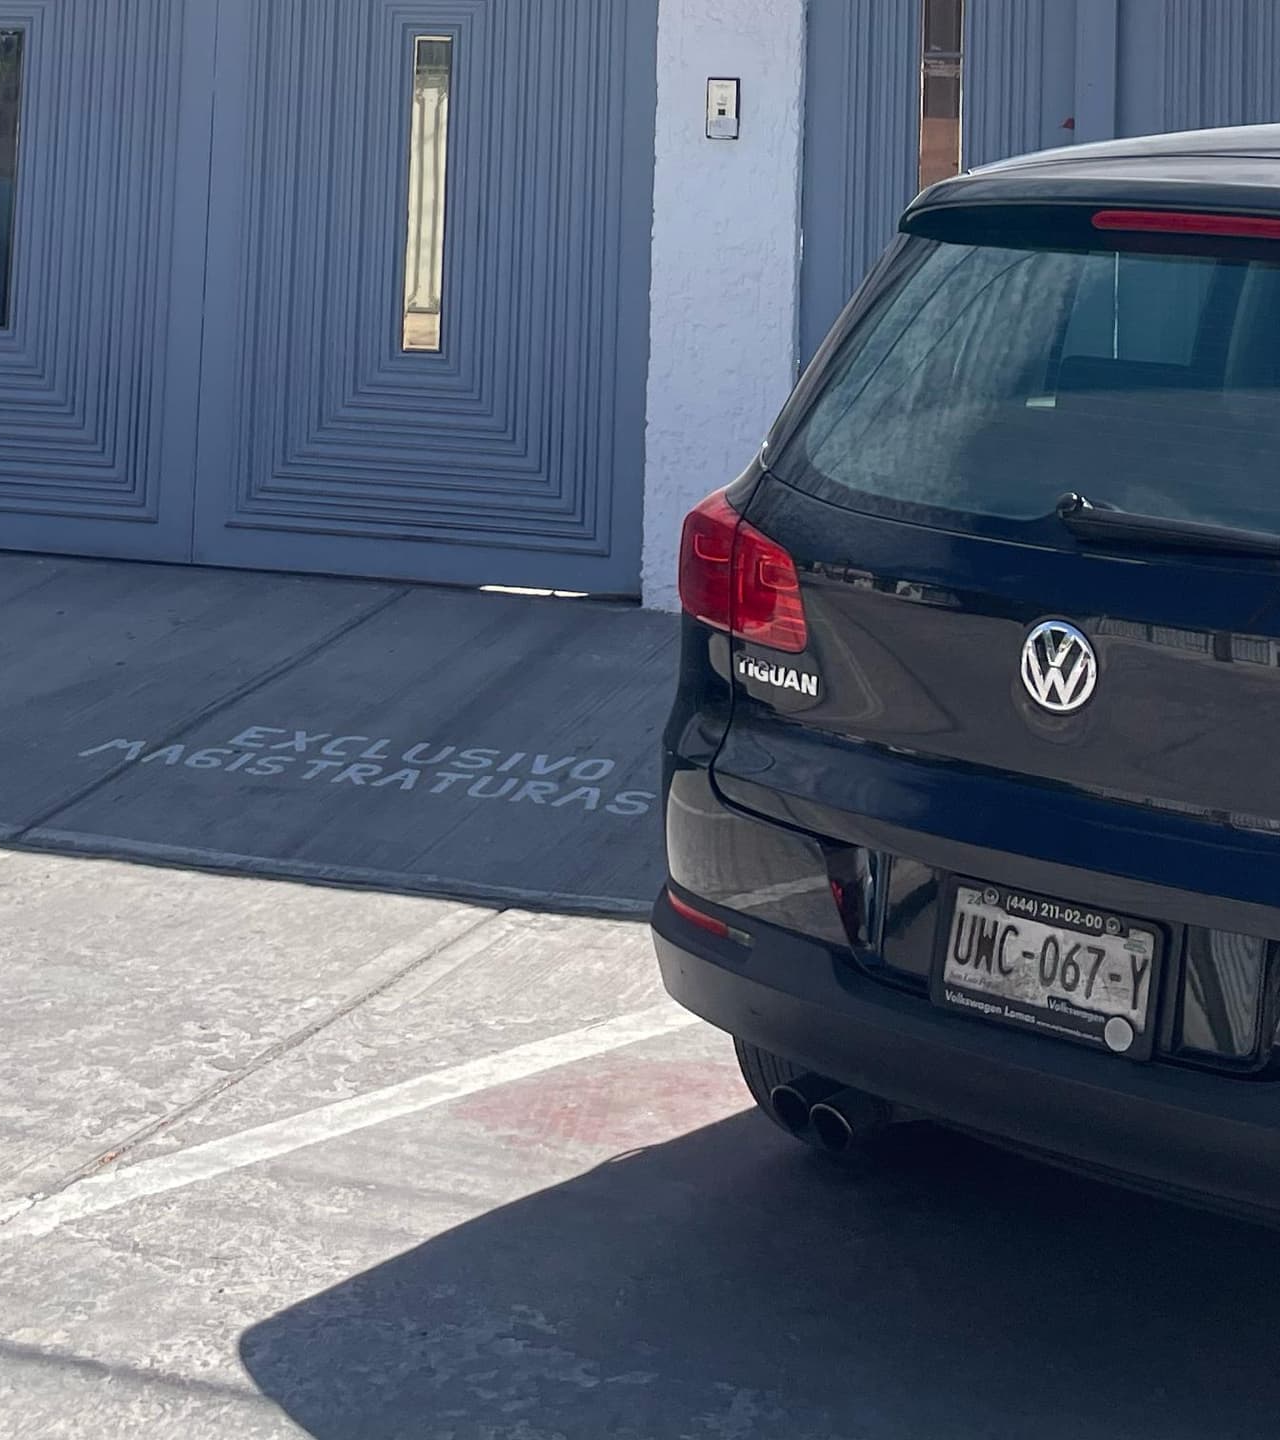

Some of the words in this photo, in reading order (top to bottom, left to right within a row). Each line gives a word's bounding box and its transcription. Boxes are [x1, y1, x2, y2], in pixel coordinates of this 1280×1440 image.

[736, 654, 819, 697] TIGUAN
[228, 725, 615, 782] EXCLUSIVO
[78, 737, 657, 816] MAGISTRATURAS
[1006, 895, 1038, 917] (444)
[1041, 902, 1103, 930] 211-02-00
[945, 989, 1002, 1015] Volkswagen
[1004, 1005, 1036, 1025] Lomas
[1048, 998, 1106, 1024] Volkswagen
